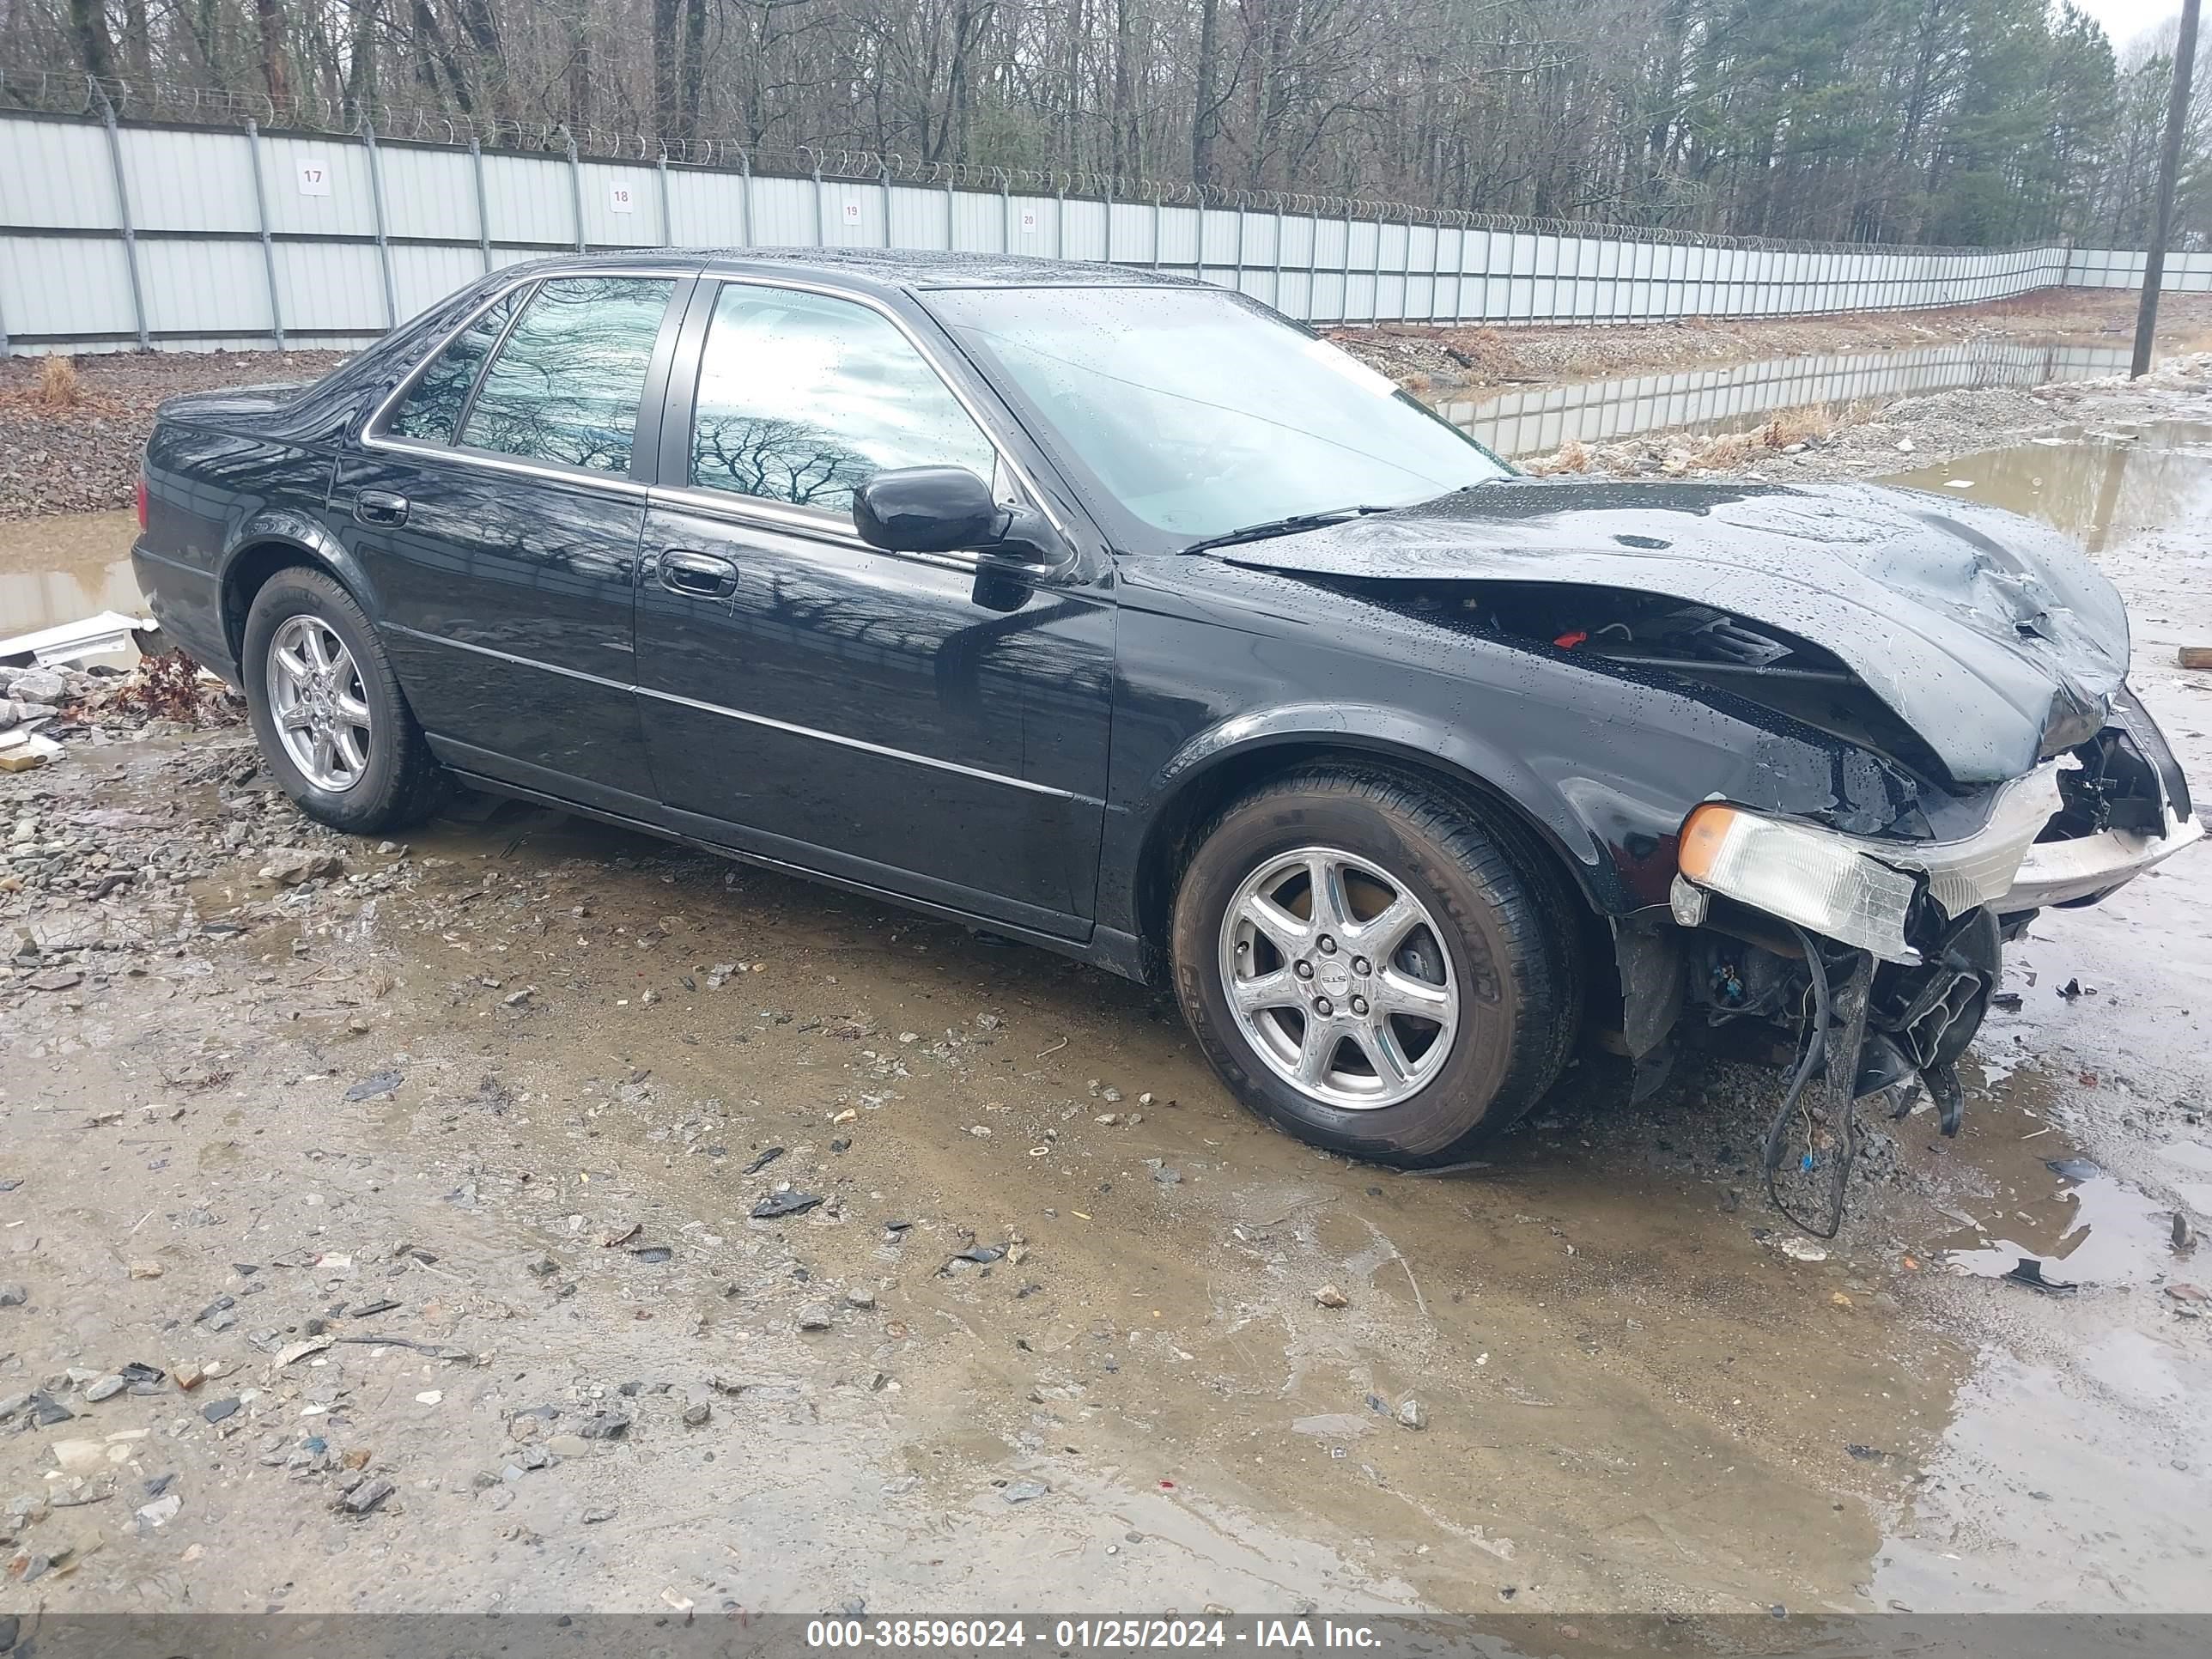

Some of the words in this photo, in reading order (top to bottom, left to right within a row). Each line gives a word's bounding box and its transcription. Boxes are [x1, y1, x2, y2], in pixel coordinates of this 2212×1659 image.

[303, 169, 323, 184] 17
[614, 191, 629, 203] 18
[846, 205, 858, 216] 19
[1024, 215, 1034, 225] 20
[1321, 975, 1347, 984] STS
